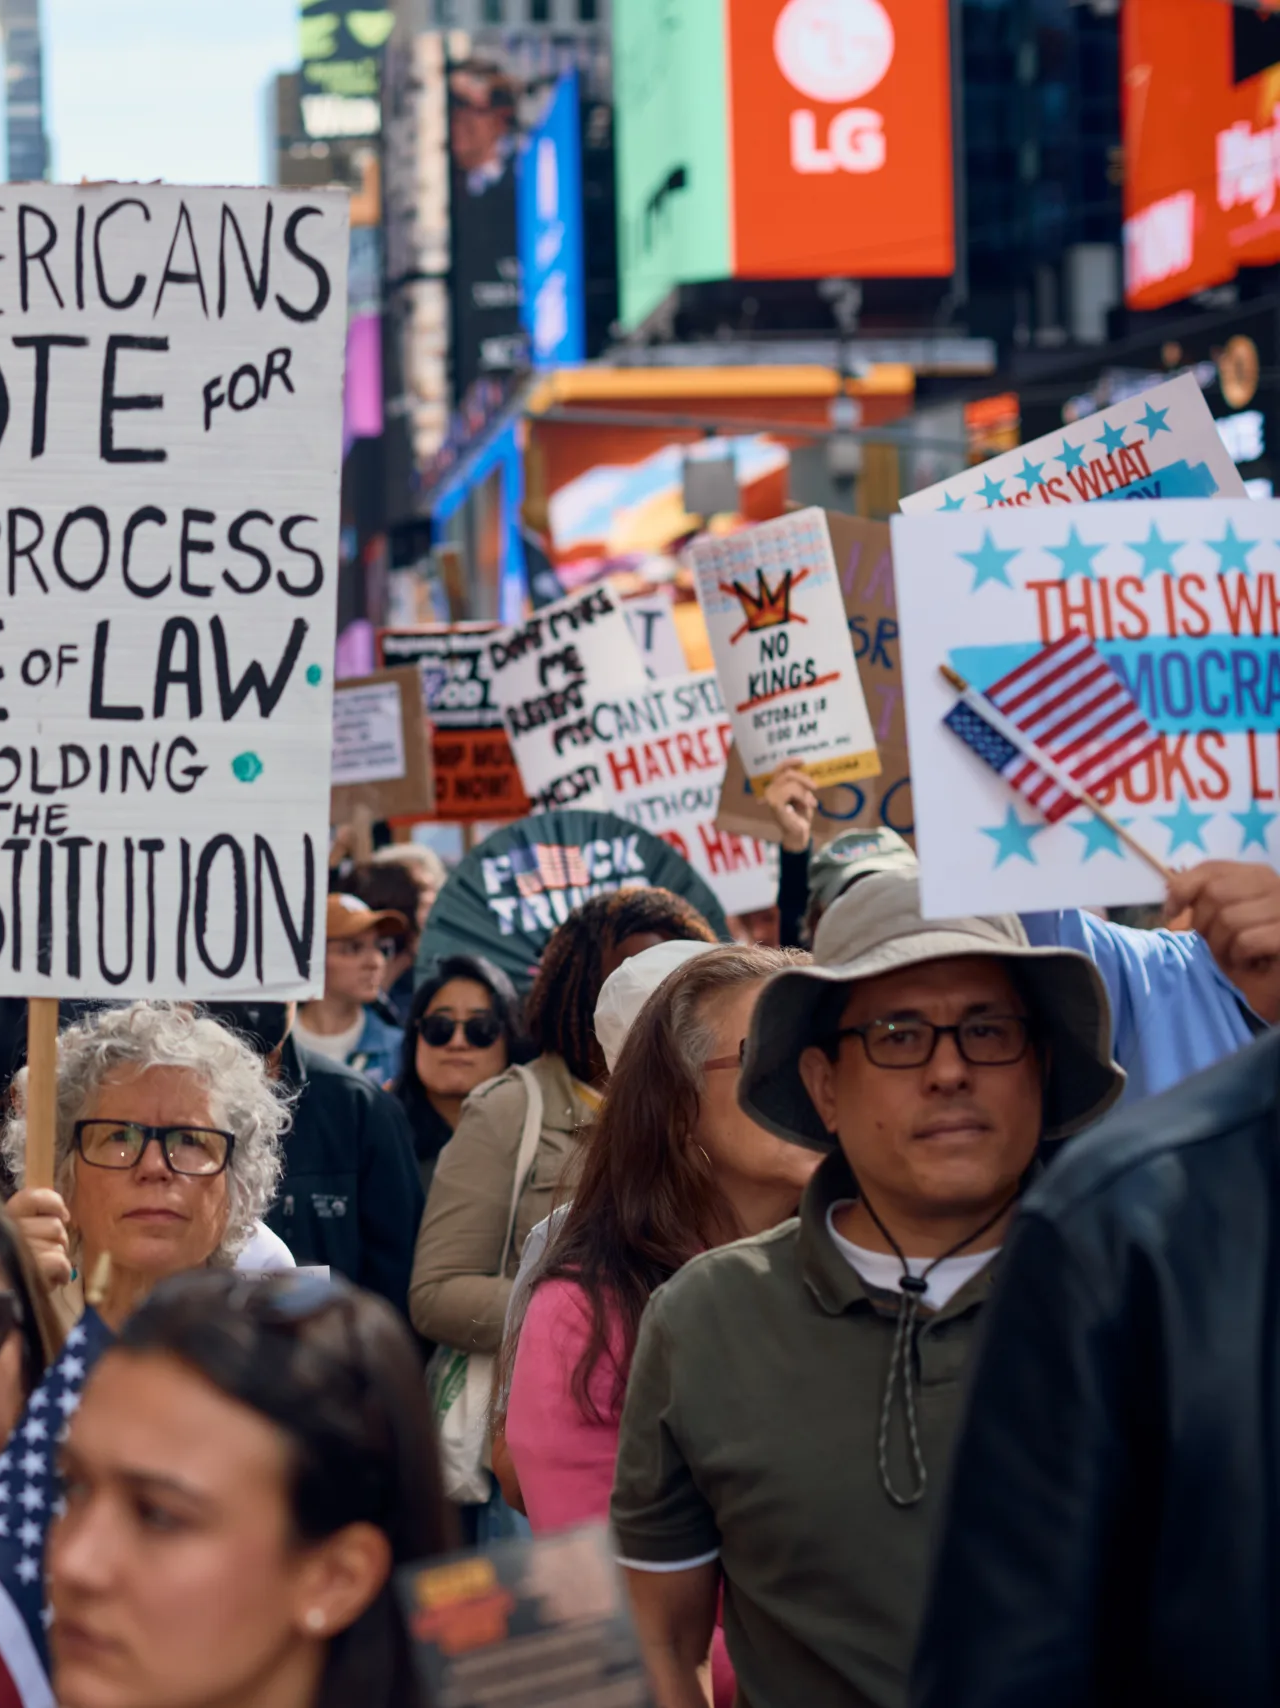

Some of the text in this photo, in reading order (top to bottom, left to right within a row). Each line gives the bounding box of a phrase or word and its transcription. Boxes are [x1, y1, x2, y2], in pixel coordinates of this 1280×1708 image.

[788, 107, 887, 174] LG
[203, 347, 295, 432] FOR
[1065, 439, 1152, 503] WHAT
[1025, 574, 1150, 648] THIS
[1163, 572, 1211, 639] IS
[21, 645, 79, 687] OF
[89, 614, 310, 722] LAW
[749, 657, 818, 702] KINGS
[760, 631, 790, 663] NO
[753, 702, 810, 730] OCTOBER
[797, 720, 818, 738] AM
[1098, 728, 1232, 806] OKS
